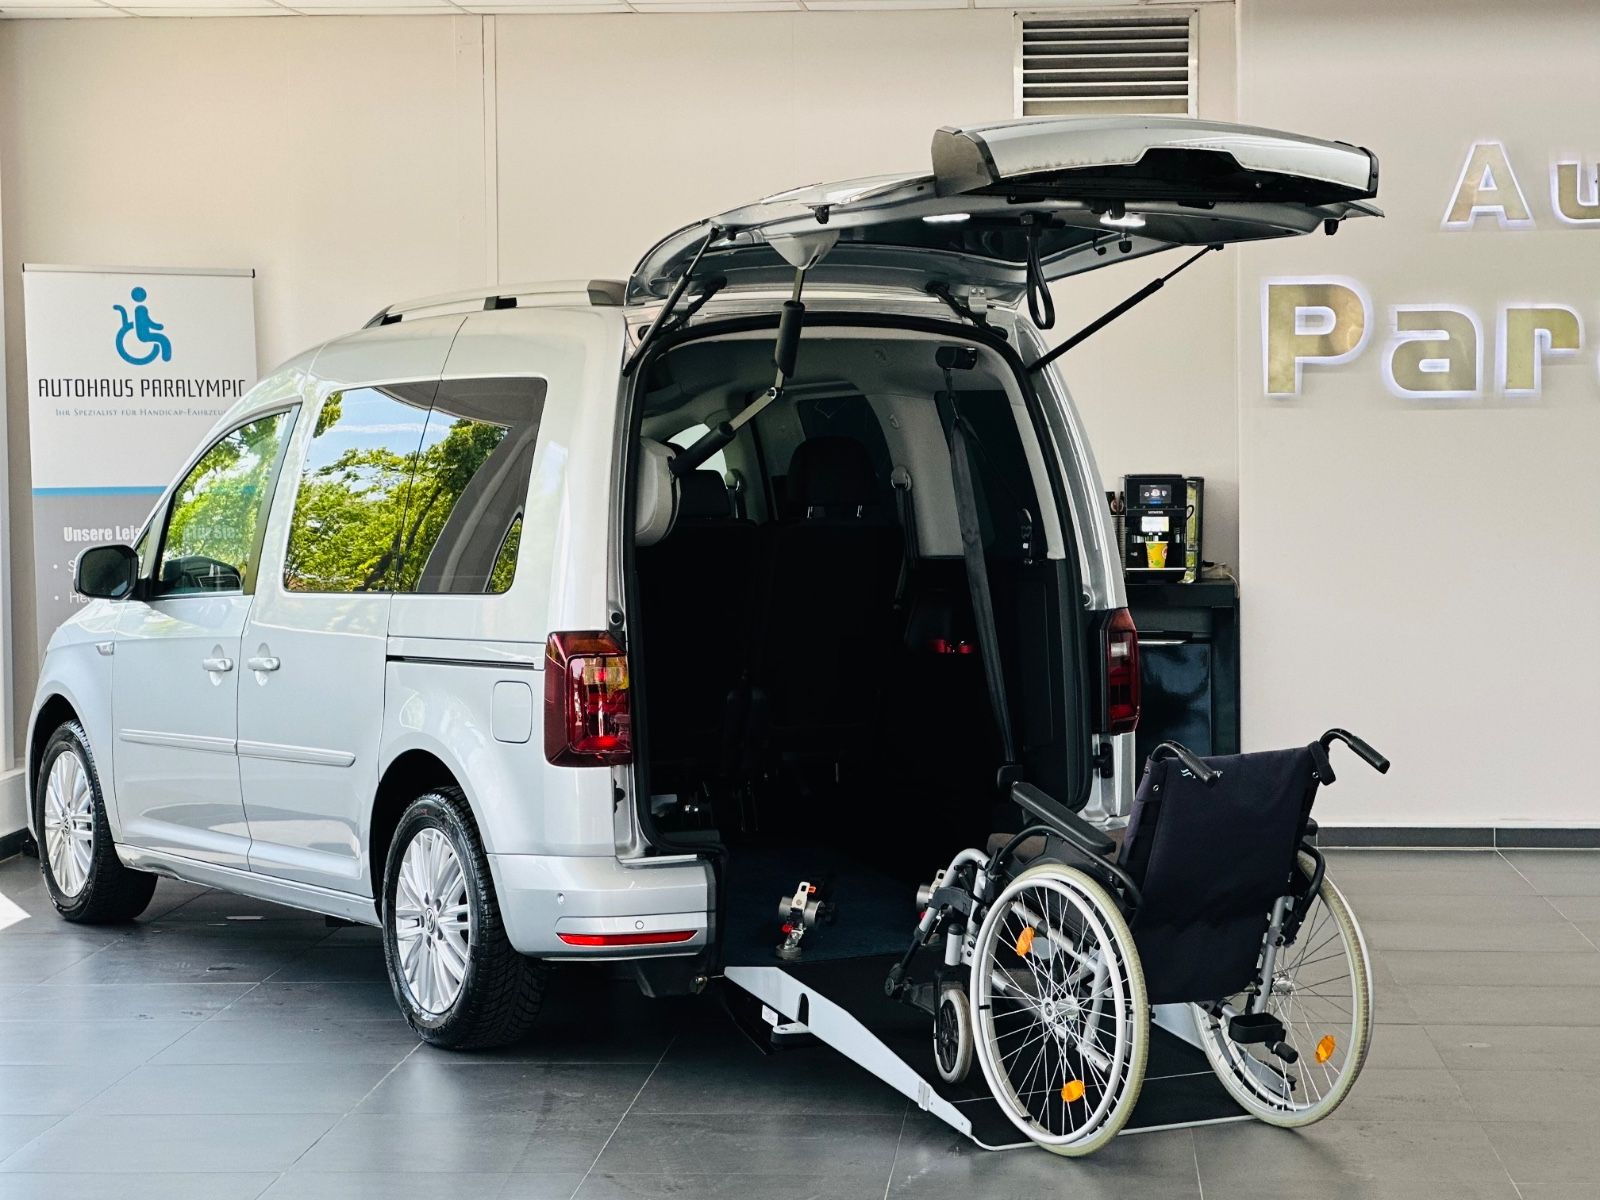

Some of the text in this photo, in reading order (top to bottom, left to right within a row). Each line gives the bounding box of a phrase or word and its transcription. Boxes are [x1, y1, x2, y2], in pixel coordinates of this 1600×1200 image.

[1441, 142, 1600, 227] Au
[1261, 276, 1600, 398] Par
[38, 378, 246, 398] AUTOHAUS PARALYMPIC
[140, 408, 227, 417] HANDICAP-FAHRZEU
[63, 526, 113, 542] Unsere
[69, 591, 90, 604] He
